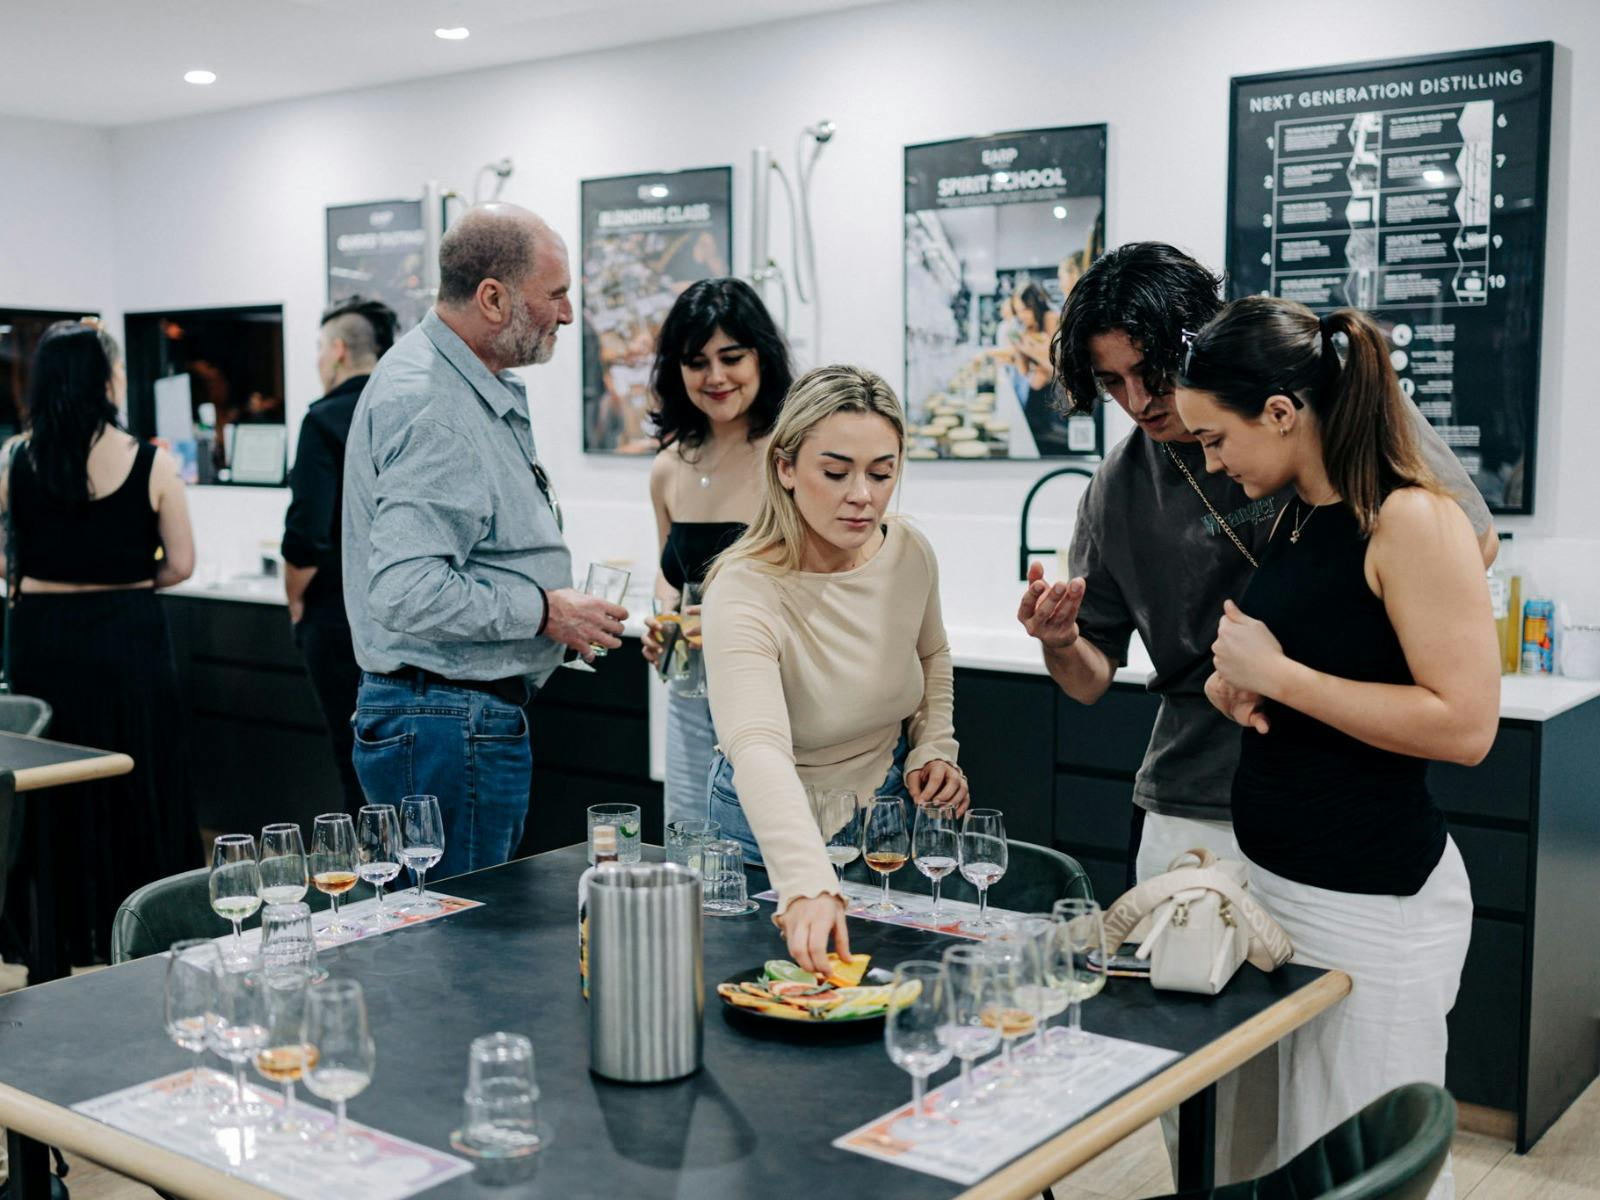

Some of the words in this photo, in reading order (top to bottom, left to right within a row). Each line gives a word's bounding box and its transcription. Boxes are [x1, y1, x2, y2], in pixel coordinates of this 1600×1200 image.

[1249, 93, 1295, 113] NEXT
[1298, 80, 1414, 108] GENERATION
[1420, 68, 1524, 96] DISTILLING
[1497, 113, 1507, 128] 6
[1266, 136, 1275, 151] 1
[1495, 153, 1506, 168] 7
[937, 173, 989, 197] SPIRIT
[990, 167, 1068, 192] SCHOOL
[1263, 174, 1274, 189] 2
[1494, 193, 1504, 209] 8
[1263, 213, 1273, 228] 3
[1492, 234, 1503, 249] 9
[1261, 252, 1271, 267] 4
[1489, 274, 1506, 289] 10
